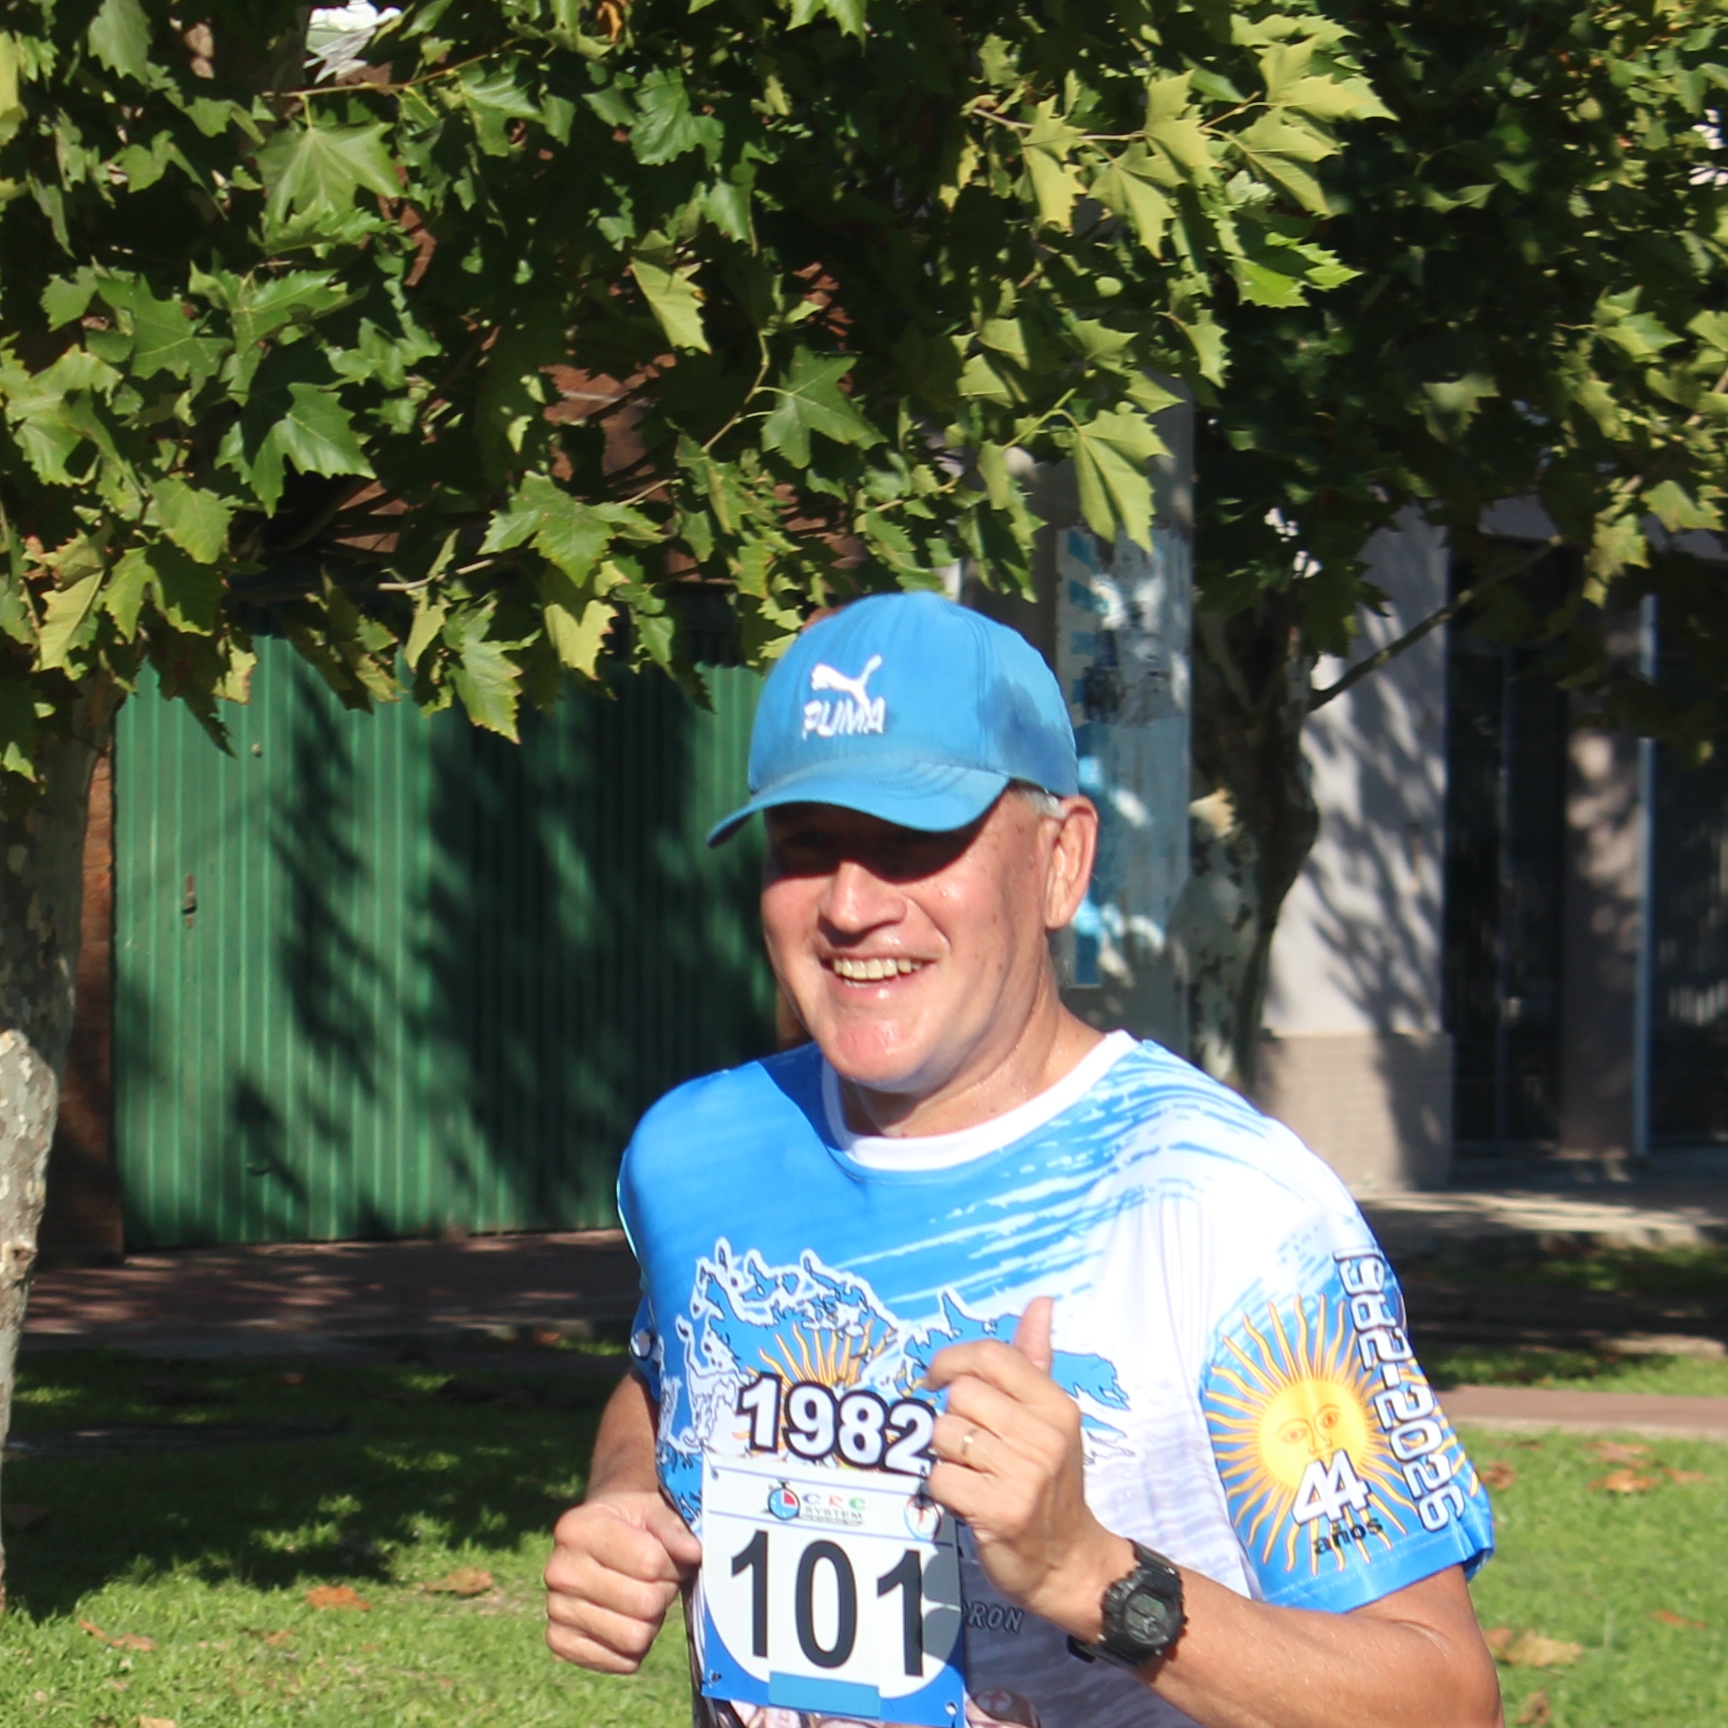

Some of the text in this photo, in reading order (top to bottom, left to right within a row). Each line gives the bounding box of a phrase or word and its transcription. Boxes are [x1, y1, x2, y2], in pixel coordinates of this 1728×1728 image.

[802, 697, 886, 740] PUMA
[737, 1371, 935, 1479] 1982
[1332, 1247, 1466, 1532] 1982-2026
[1290, 1448, 1372, 1527] 44
[1312, 1518, 1385, 1556] años
[730, 1529, 924, 1678] 101
